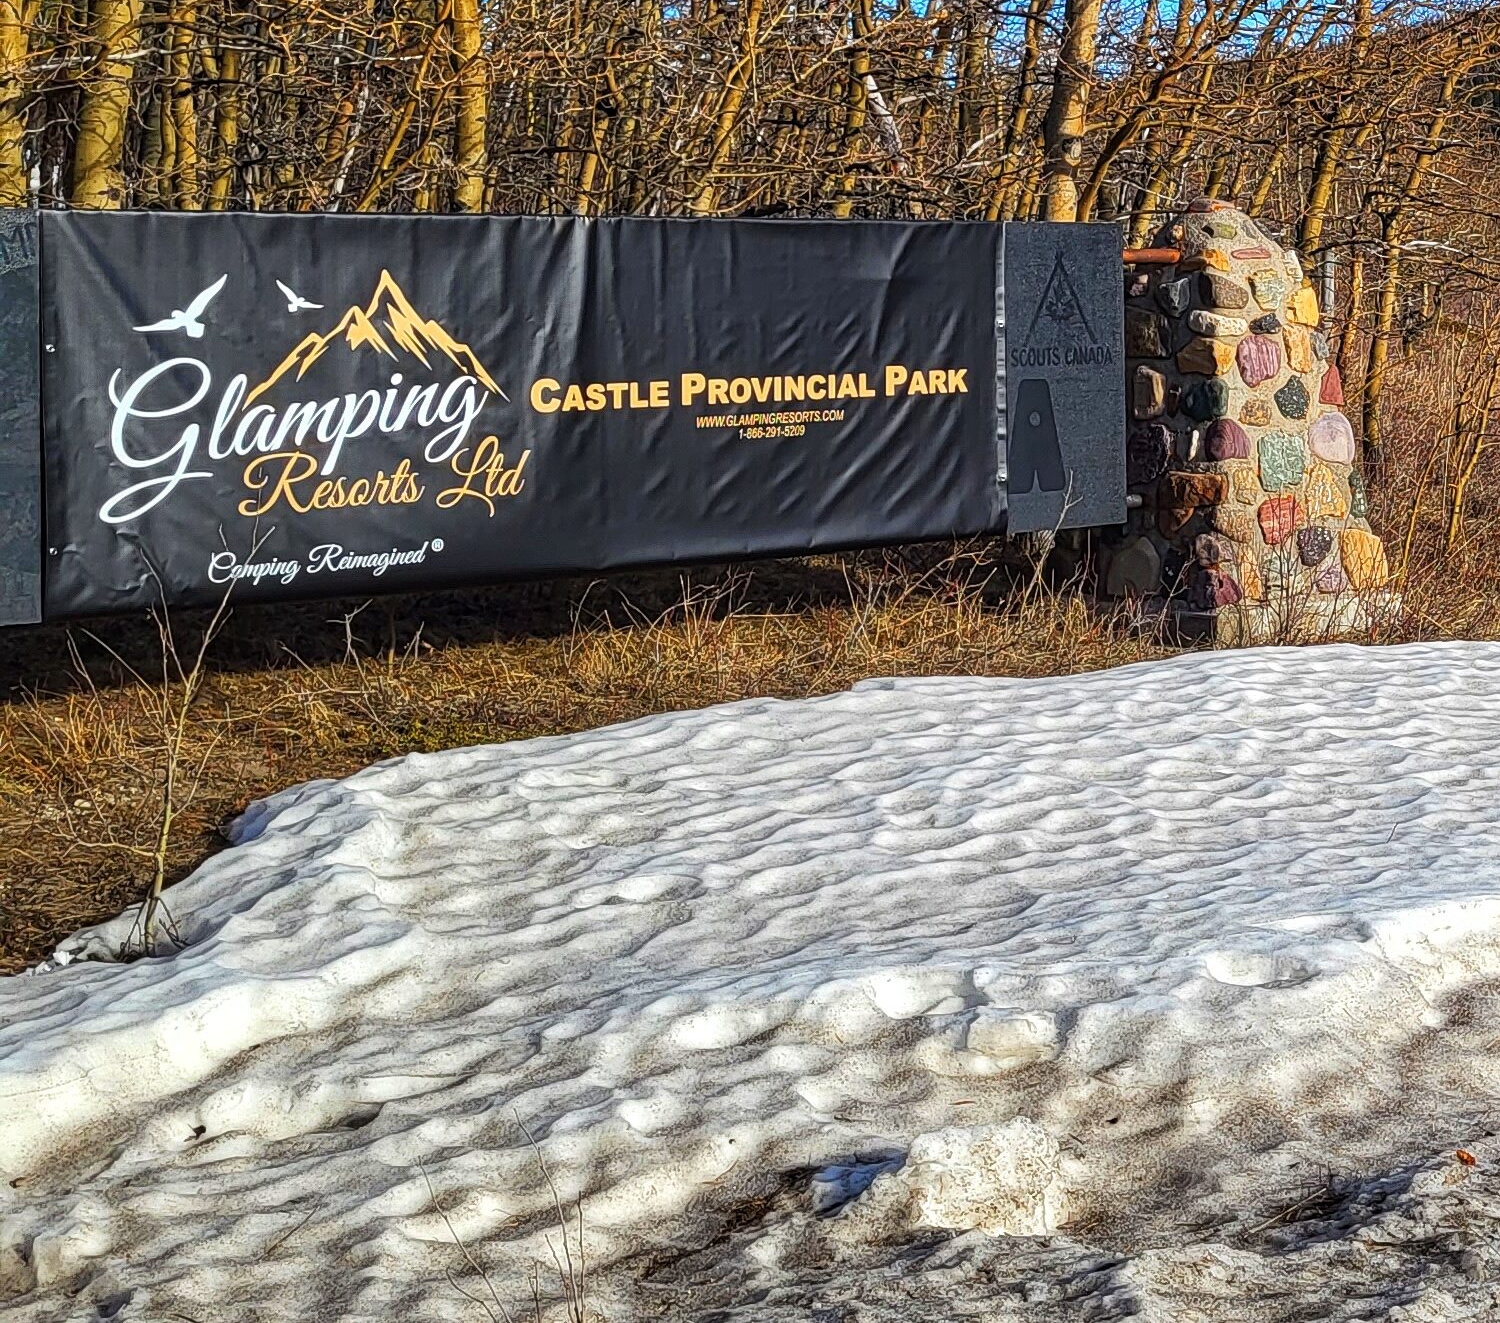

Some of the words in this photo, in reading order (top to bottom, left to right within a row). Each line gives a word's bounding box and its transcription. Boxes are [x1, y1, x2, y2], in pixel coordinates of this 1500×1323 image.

[1010, 346, 1061, 367] SCOUTS
[1064, 344, 1113, 365] CANADA
[530, 378, 670, 413] CASTLE
[681, 372, 876, 406] PROVINCIAL
[885, 365, 968, 397] PARK
[696, 410, 845, 428] WWW.GLAMPINGRESORTS.COM
[738, 425, 805, 440] 1-866-291-5209
[98, 357, 489, 524] Glamping
[238, 451, 425, 517] Resorts
[435, 435, 531, 518] Ltd
[207, 551, 301, 585] Camping
